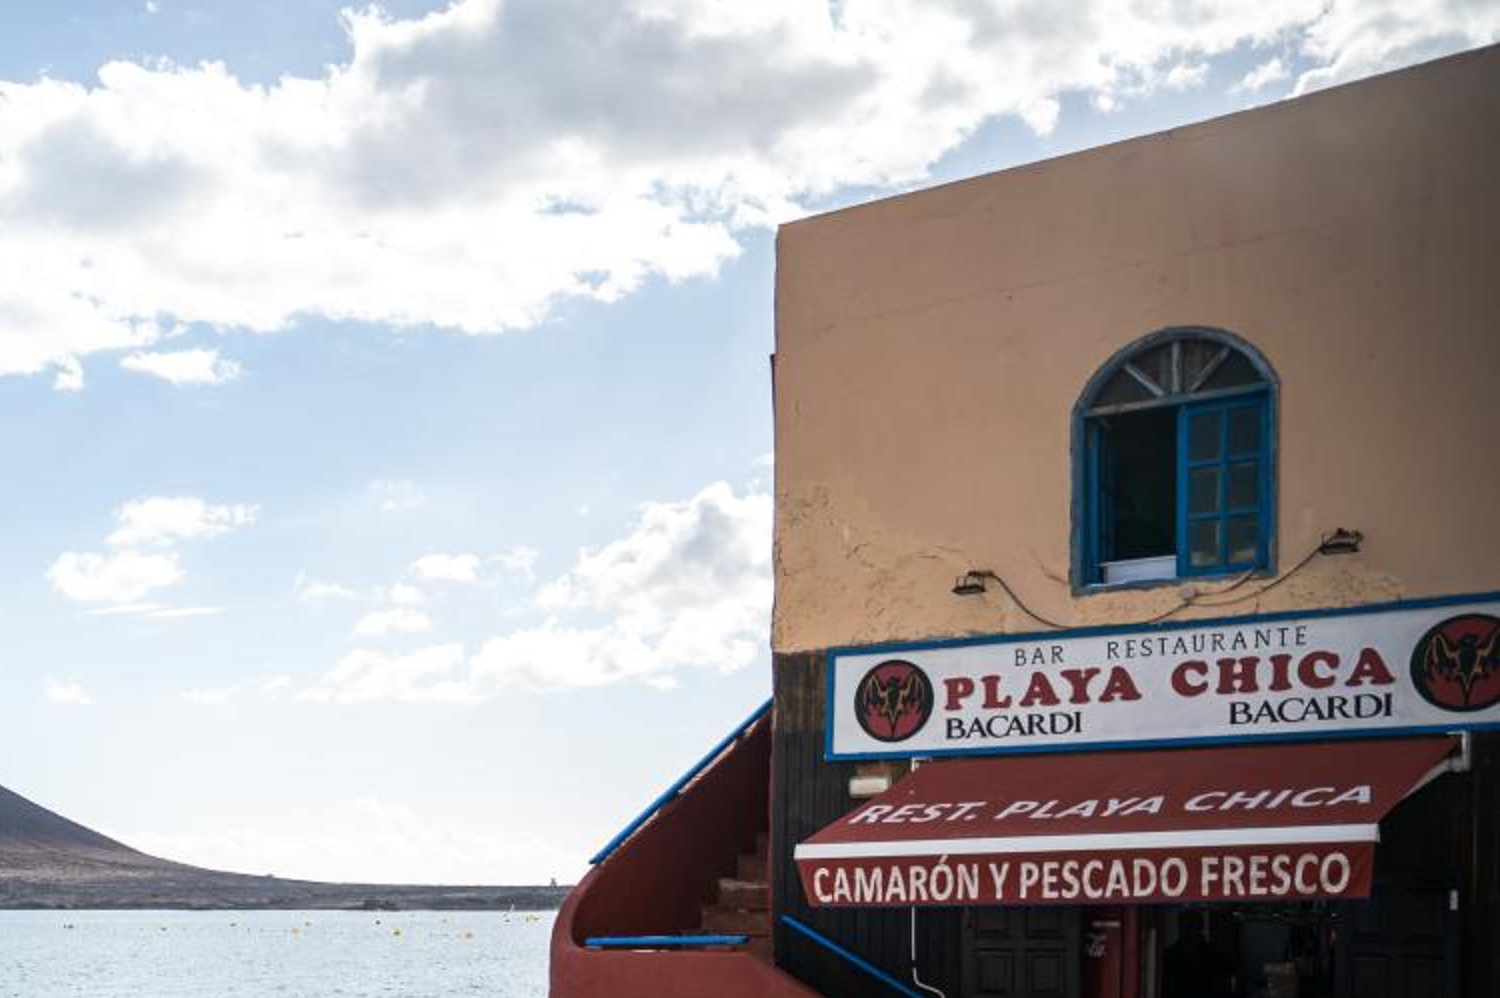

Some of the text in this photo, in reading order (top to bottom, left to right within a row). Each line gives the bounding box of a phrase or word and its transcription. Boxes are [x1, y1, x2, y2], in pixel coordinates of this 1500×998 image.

[1014, 625, 1308, 667] BAR RESTAURANTE
[943, 647, 1396, 711] PLAYA CHICA
[945, 711, 1082, 740] BACARDI
[1228, 693, 1393, 725] BACARDI
[849, 785, 1372, 824] REST. PLAYA CHICA
[813, 852, 1350, 903] CAMARÓN Y PESCADO FRESCO
